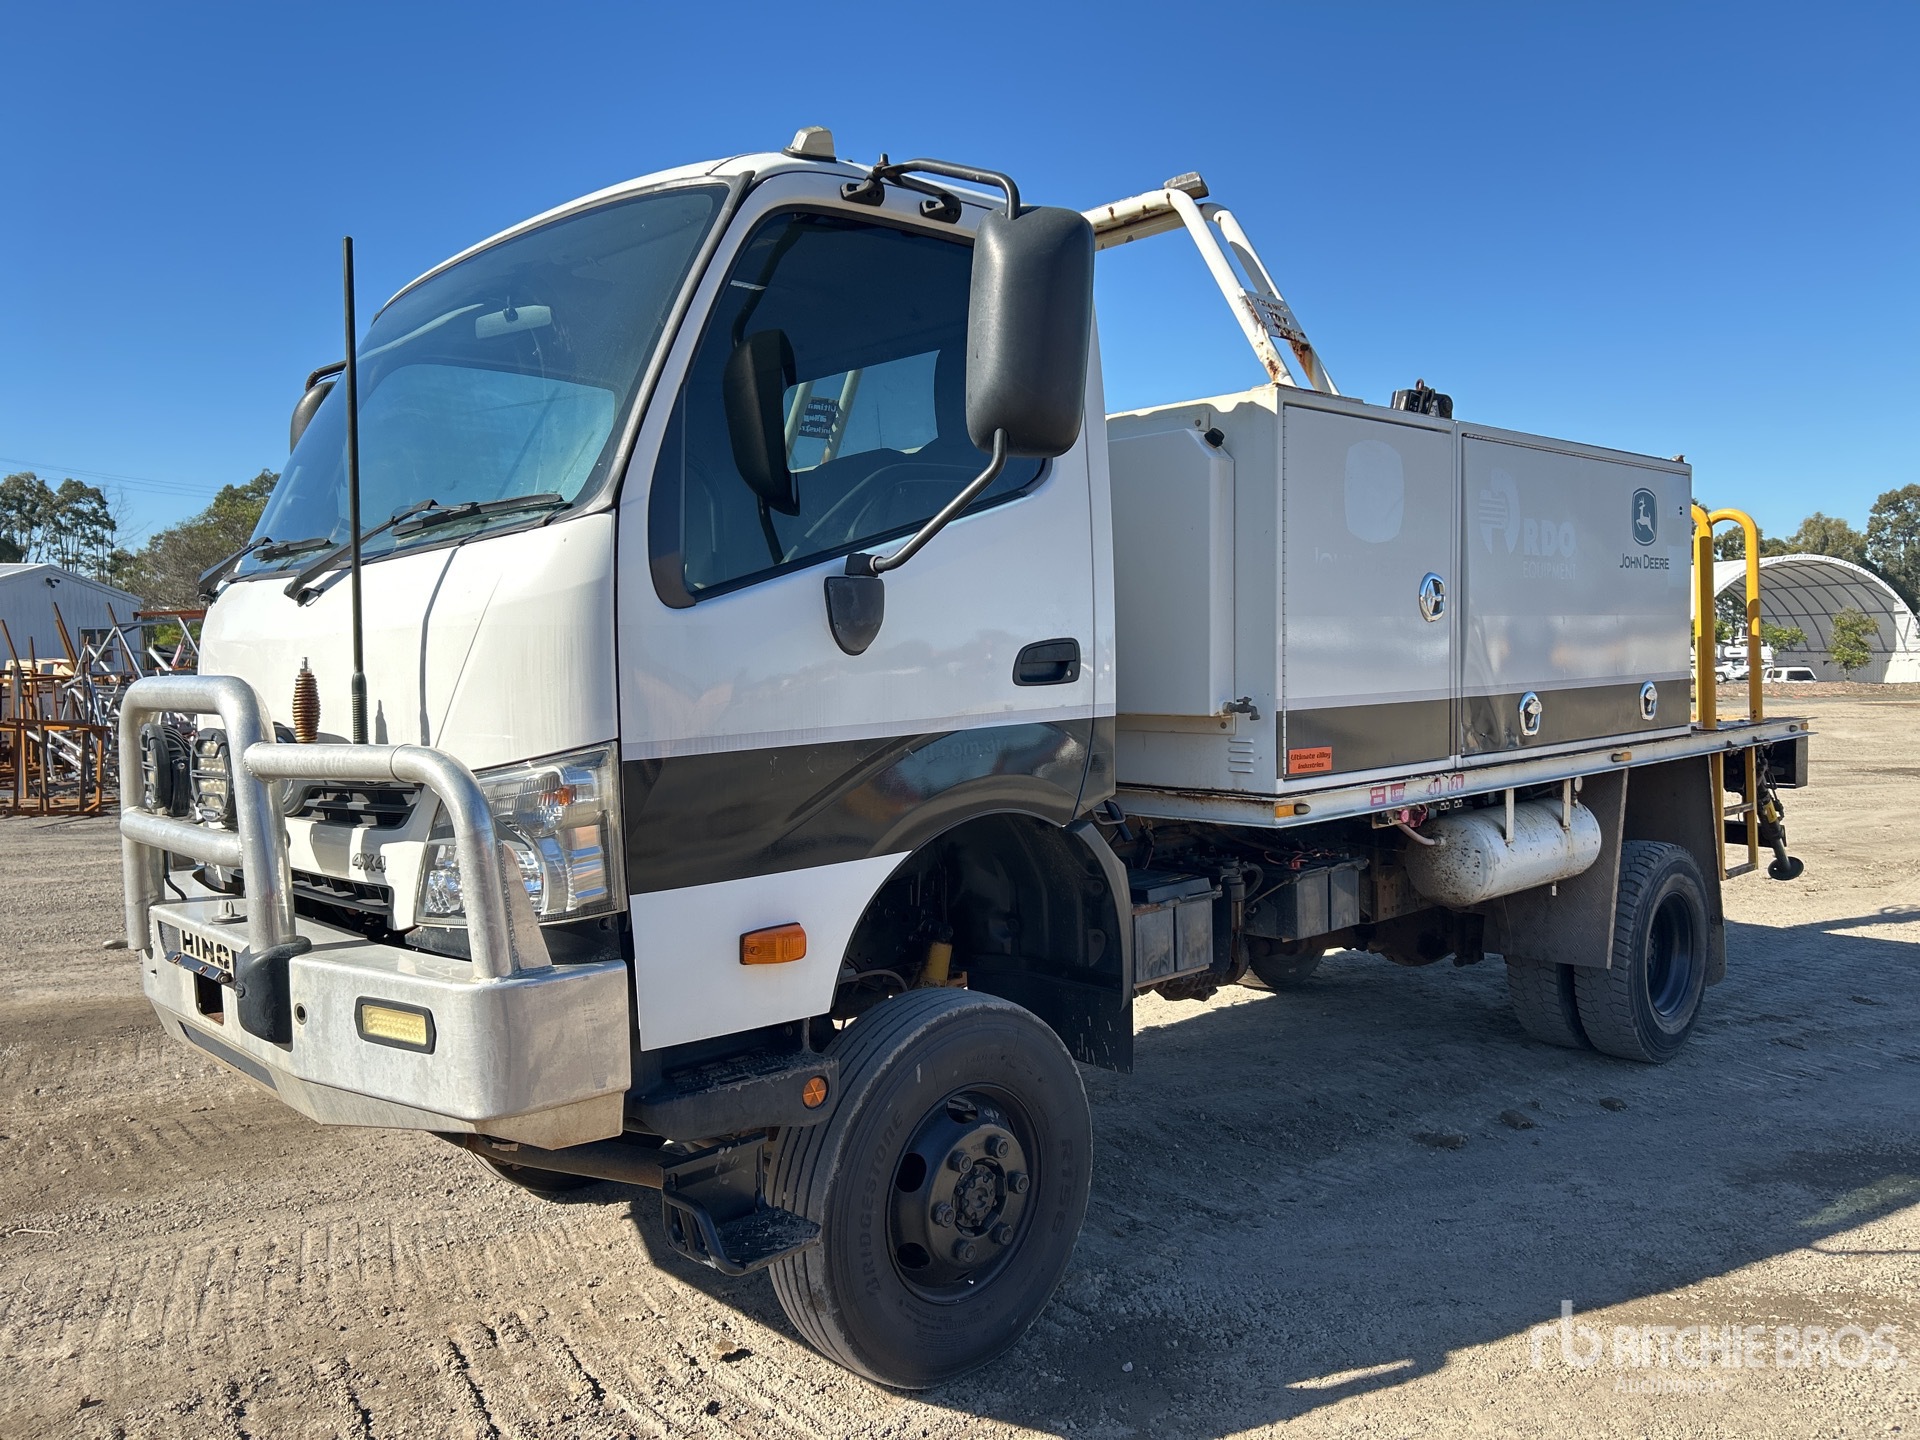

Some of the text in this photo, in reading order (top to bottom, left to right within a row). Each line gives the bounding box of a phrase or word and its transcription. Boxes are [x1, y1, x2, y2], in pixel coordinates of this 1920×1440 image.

[1523, 518, 1577, 558] RDO
[1522, 561, 1576, 580] EQUIPMENT
[1619, 553, 1670, 570] JOHN DEERE
[352, 852, 387, 873] 4X4
[181, 929, 230, 970] HINO
[859, 1111, 904, 1298] BRIDGESTONE
